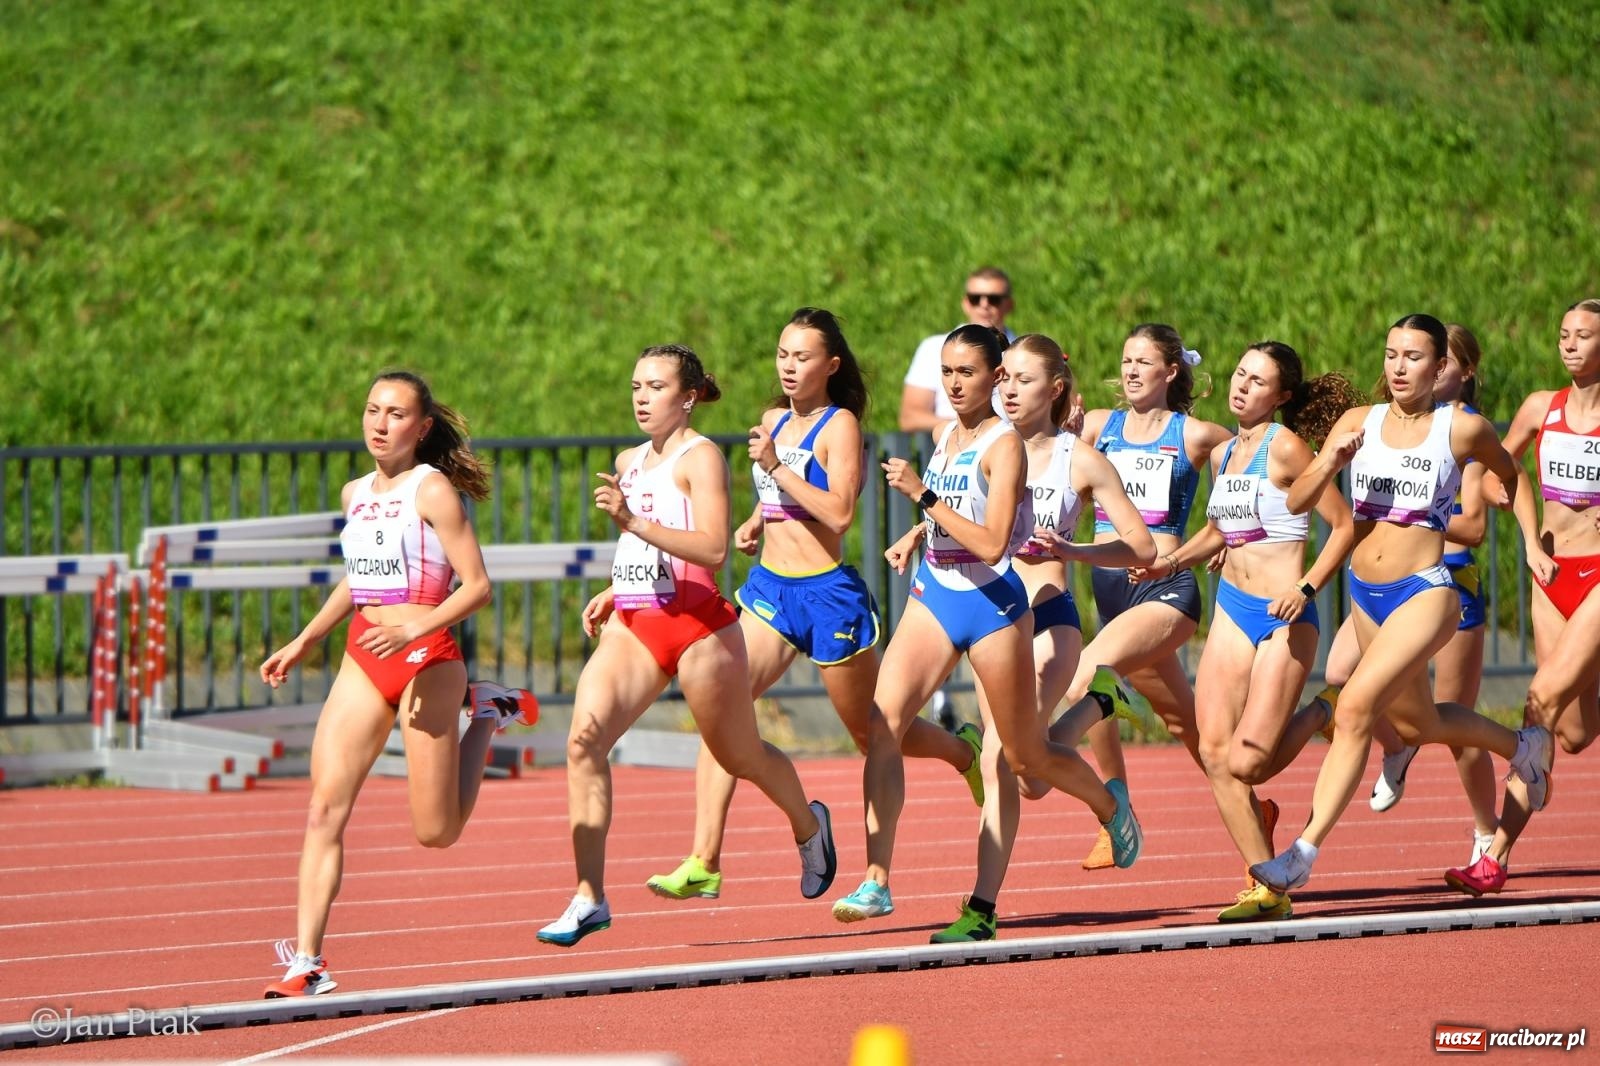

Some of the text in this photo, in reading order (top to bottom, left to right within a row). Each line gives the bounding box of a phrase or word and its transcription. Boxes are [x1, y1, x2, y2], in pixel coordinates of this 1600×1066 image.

[1135, 457, 1165, 471] 507
[1400, 455, 1432, 472] 308
[1032, 486, 1056, 501] 07
[1125, 482, 1146, 498] AN
[1226, 479, 1251, 493] 108
[1356, 472, 1429, 500] HVORKOVÁ
[375, 530, 384, 546] 8
[346, 557, 403, 577] WCZARUK
